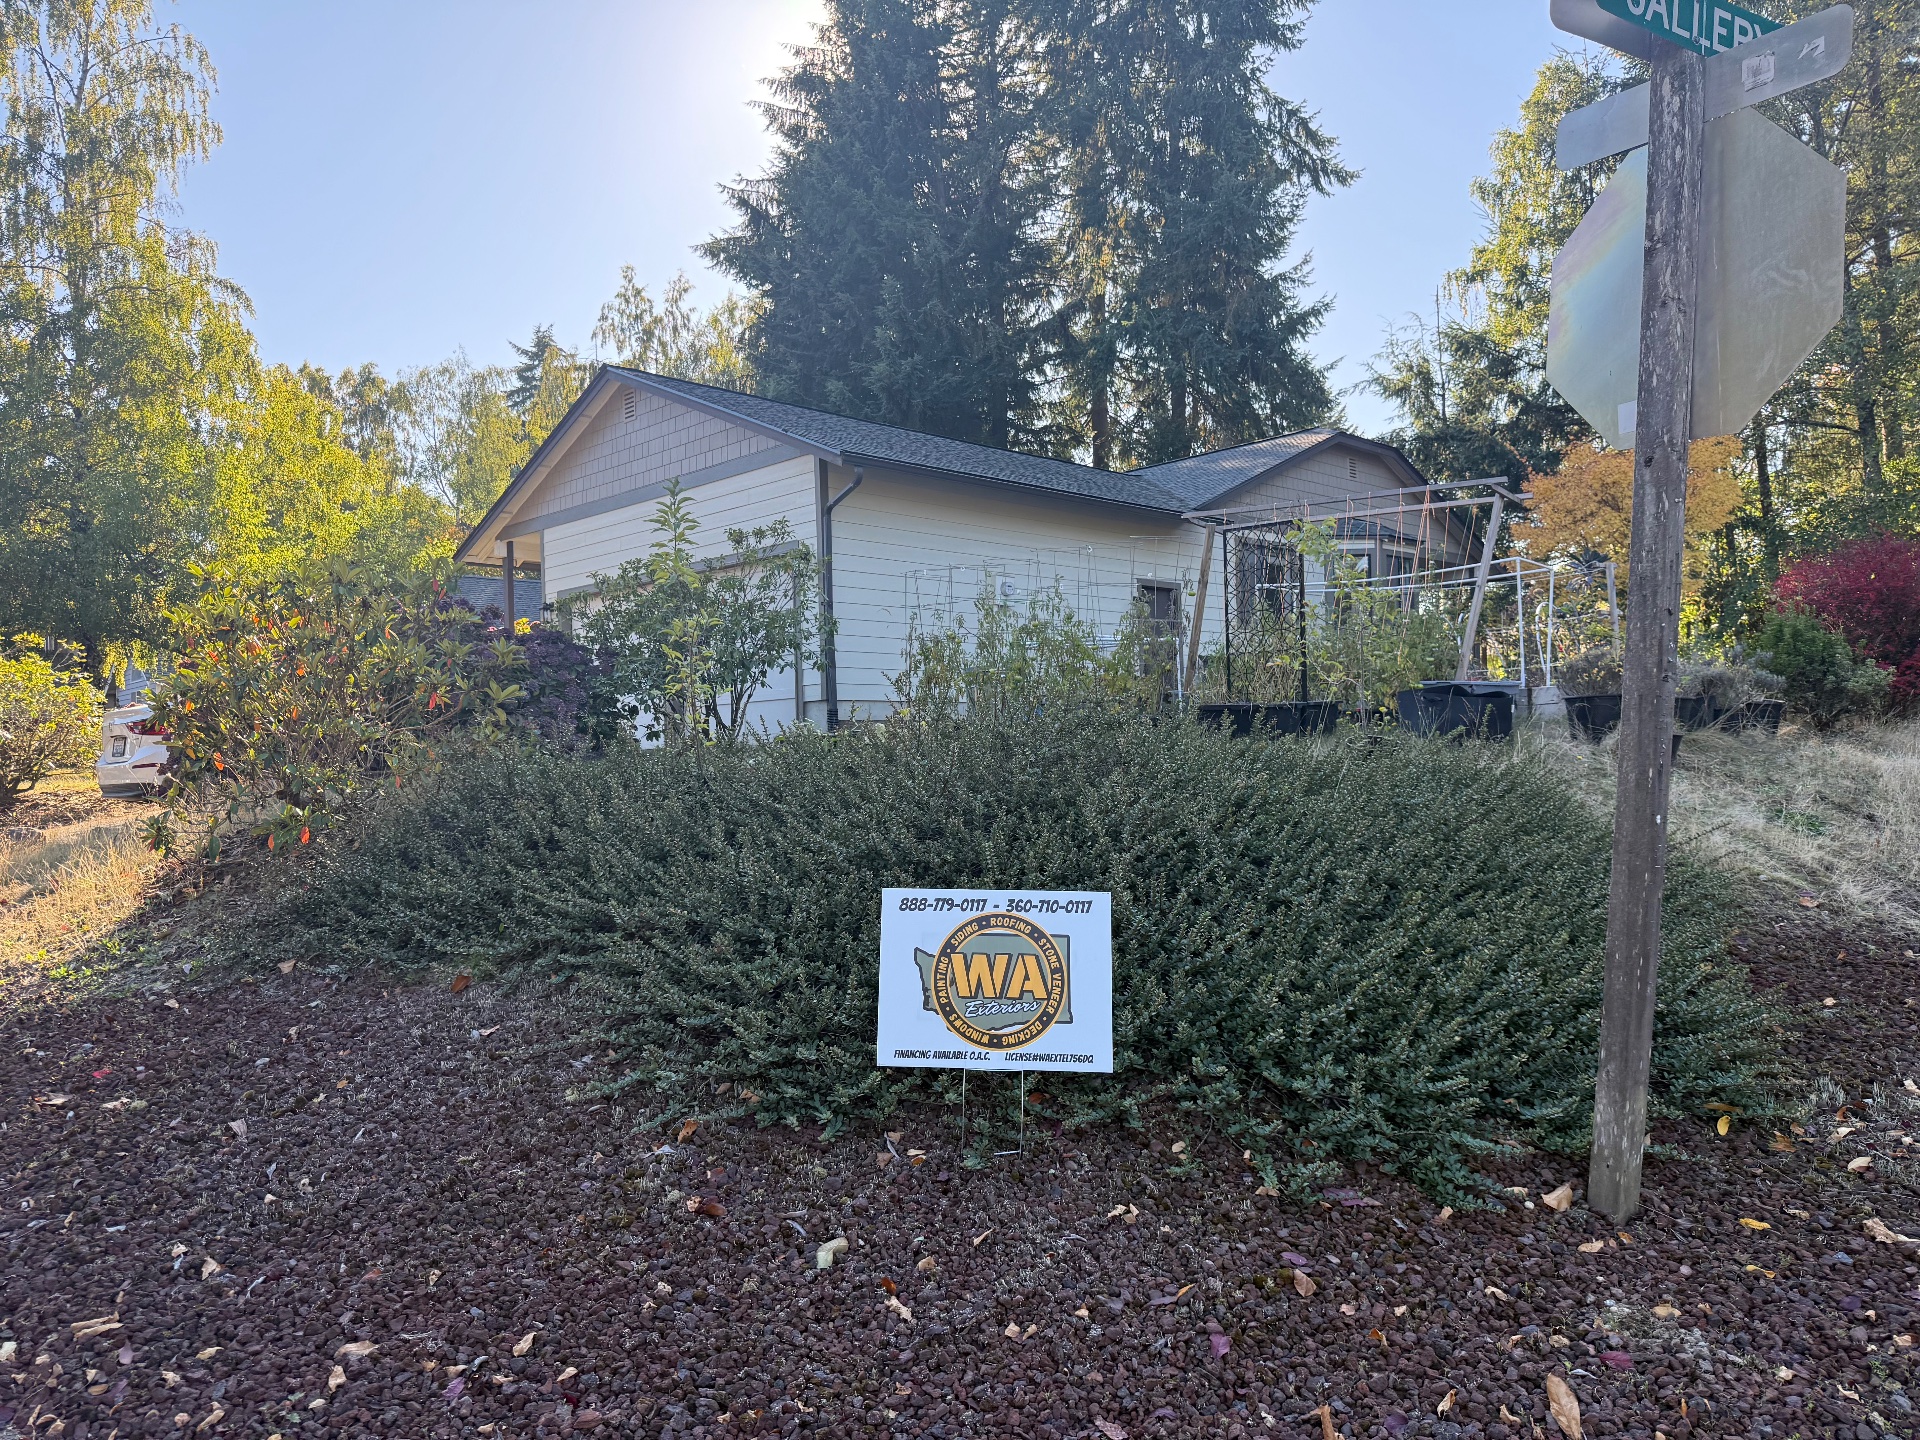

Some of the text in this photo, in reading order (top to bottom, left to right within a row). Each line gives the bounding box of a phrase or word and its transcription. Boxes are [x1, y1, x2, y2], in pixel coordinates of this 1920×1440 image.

[1006, 899, 1093, 914] 360-710-0117
[937, 917, 1062, 1045] SIDING ROOFING STONE VENEER DECKING WINDOWS PAINTING
[950, 953, 1048, 999] WA
[965, 1000, 1041, 1018] Exteriors
[893, 1049, 991, 1061] FINANCING AVAILABLE O.A.C.
